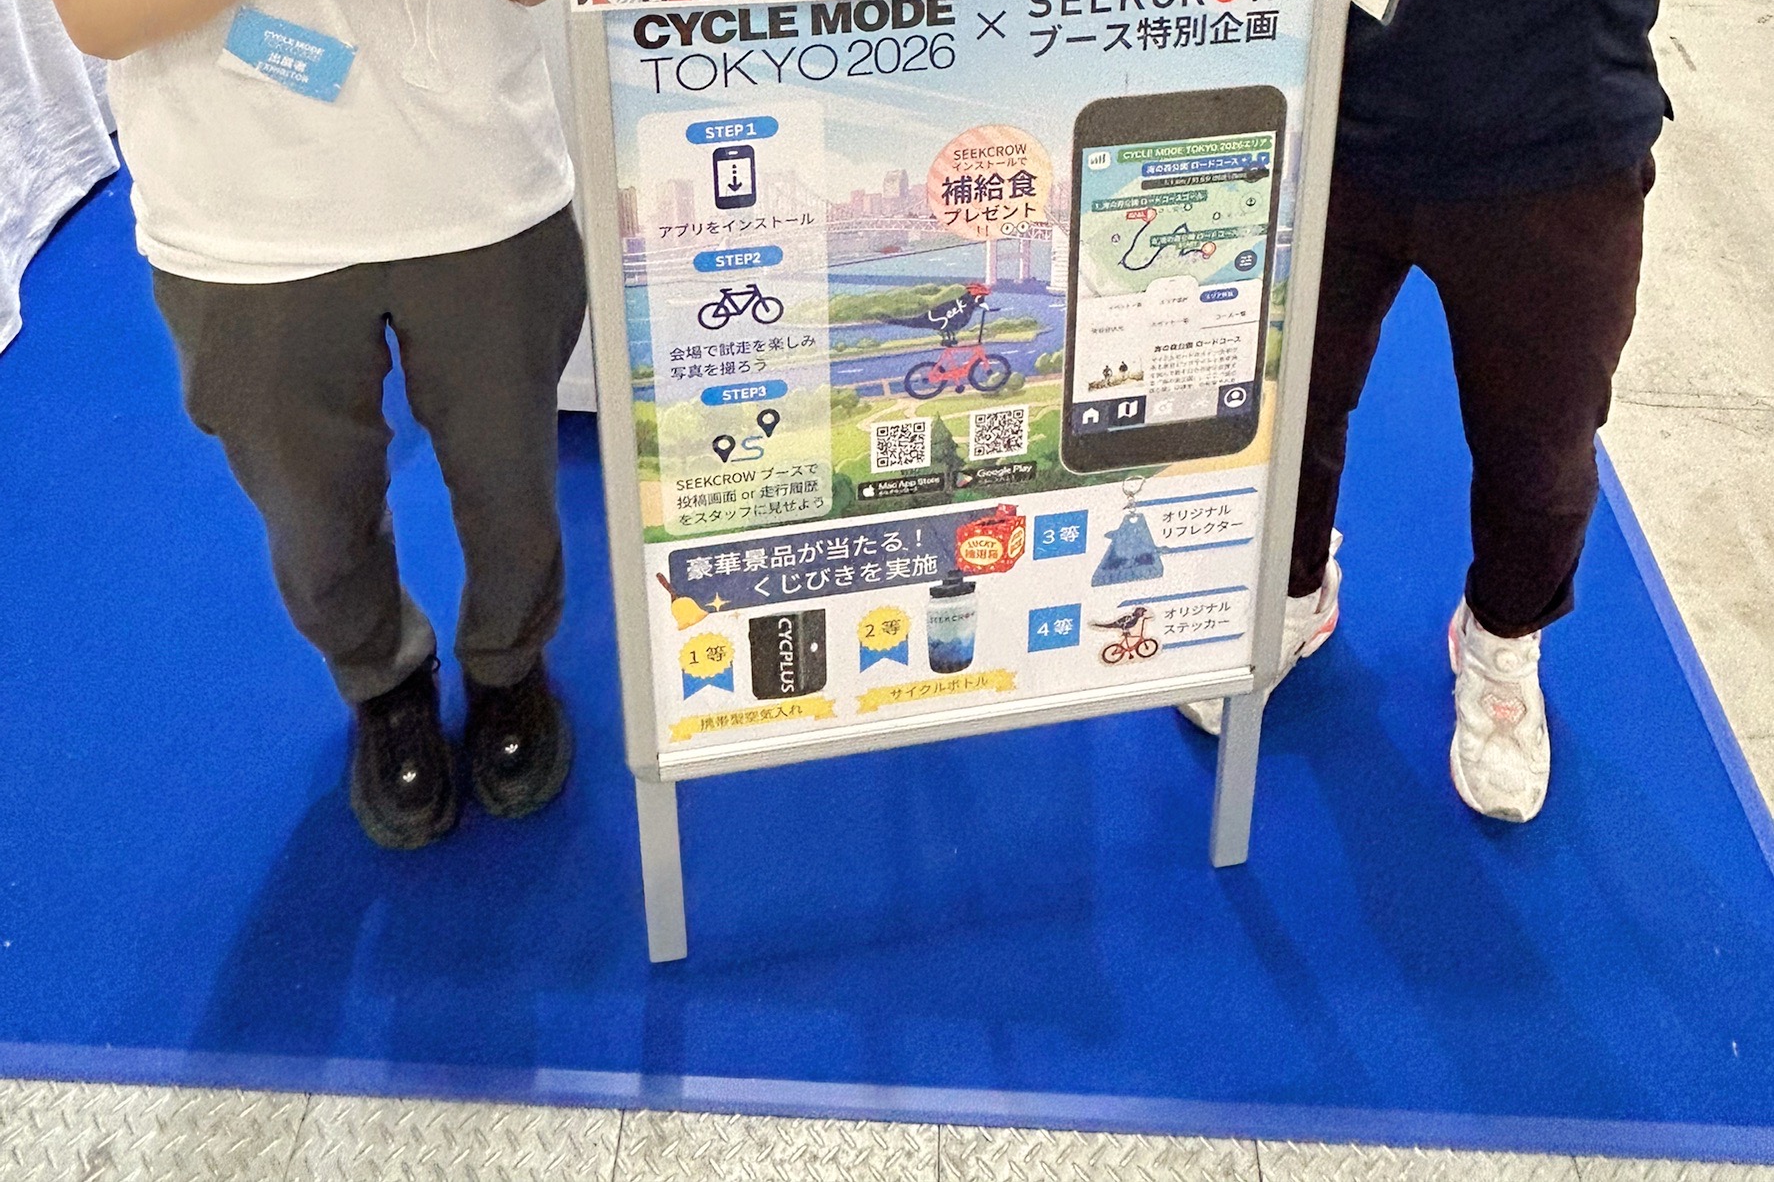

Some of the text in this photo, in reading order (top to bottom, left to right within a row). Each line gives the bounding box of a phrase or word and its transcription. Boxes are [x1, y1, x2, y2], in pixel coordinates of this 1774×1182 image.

[633, 5, 799, 50] CYCLE
[1030, 10, 1280, 58] ブース特別企画
[640, 33, 955, 94] TOKYO 2026
[953, 144, 1027, 161] SEEKCROW
[953, 157, 1028, 172] インストールで
[942, 169, 1038, 206] 補給食
[944, 203, 1037, 226] プレゼント
[659, 214, 815, 239] アプリをインストール
[715, 252, 761, 268] STEP2
[928, 298, 967, 329] Seek
[669, 335, 816, 362] 会場で試走を楽しみ
[670, 358, 768, 380] 写真を撮ろう
[722, 386, 767, 401] STEP3
[676, 463, 819, 491] SEEKCROW ブースで
[976, 465, 1033, 479] Google Play
[676, 480, 819, 509] 投稿画面 or 走行履歴
[899, 479, 917, 489] App
[679, 496, 825, 526] をスタッフに見せよう
[1162, 505, 1232, 523] オリジナル
[1162, 520, 1243, 539] リフレクター
[967, 540, 997, 549] LUCKY
[753, 554, 938, 597] くじびきを実施
[1164, 601, 1232, 619] オリジナル
[1164, 618, 1230, 636] ステッカー
[778, 617, 795, 693] CYCPLUS
[890, 677, 988, 700] サイクルボトル
